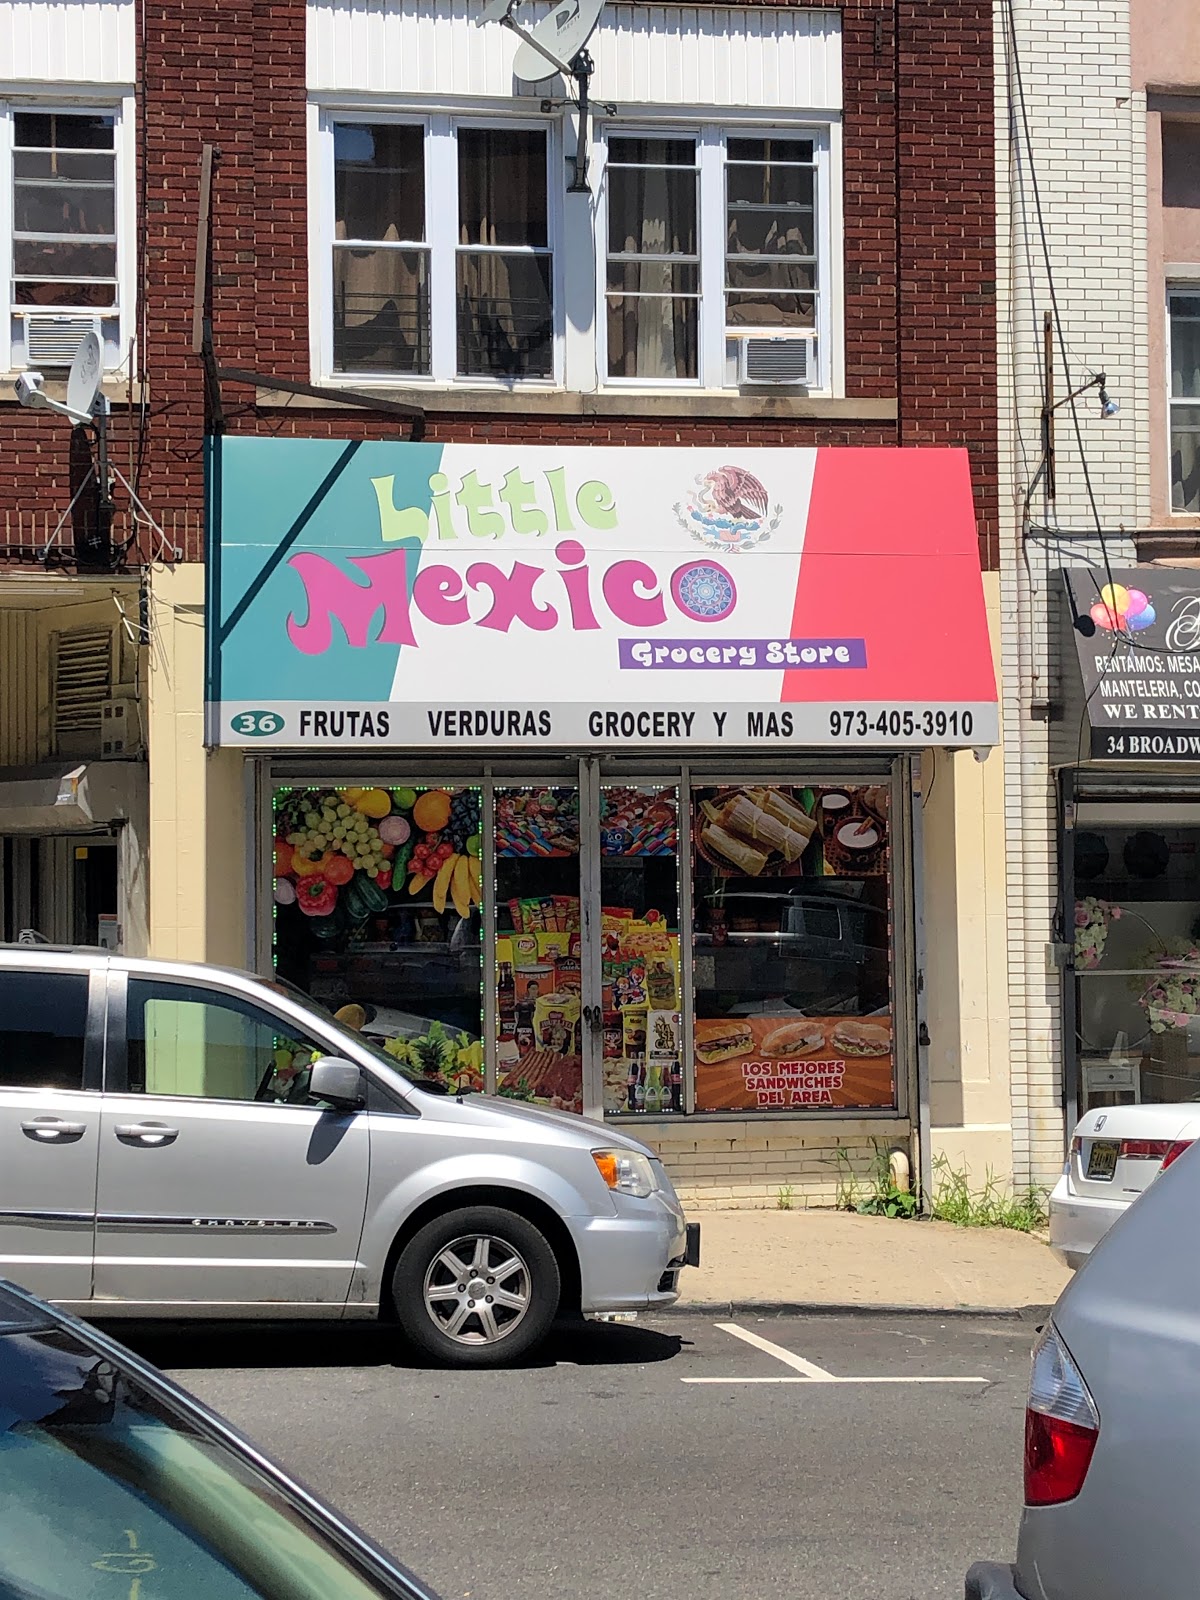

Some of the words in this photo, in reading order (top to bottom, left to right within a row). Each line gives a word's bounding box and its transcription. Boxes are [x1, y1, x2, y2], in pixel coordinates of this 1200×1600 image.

[370, 466, 617, 543] Little
[286, 540, 738, 655] Mexico
[631, 641, 757, 667] Grocery
[765, 641, 851, 665] Store
[1095, 655, 1165, 674] RENTAMOS:
[1100, 680, 1183, 699] MANTELERIA,
[1103, 704, 1138, 719] WE
[239, 714, 276, 733] 36
[300, 710, 390, 737] FRUTAS
[428, 710, 552, 737] VERDURAS
[589, 711, 696, 738] GROCERY
[712, 711, 728, 737] Y
[747, 711, 794, 737] MAS
[829, 710, 973, 737] 973-405-3910
[1107, 736, 1124, 754] 34
[742, 1062, 771, 1076] LOS
[777, 1060, 846, 1076] MEJORES
[745, 1075, 843, 1091] SANDWICHES
[757, 1090, 784, 1105] DEL
[791, 1090, 832, 1104] AREA
